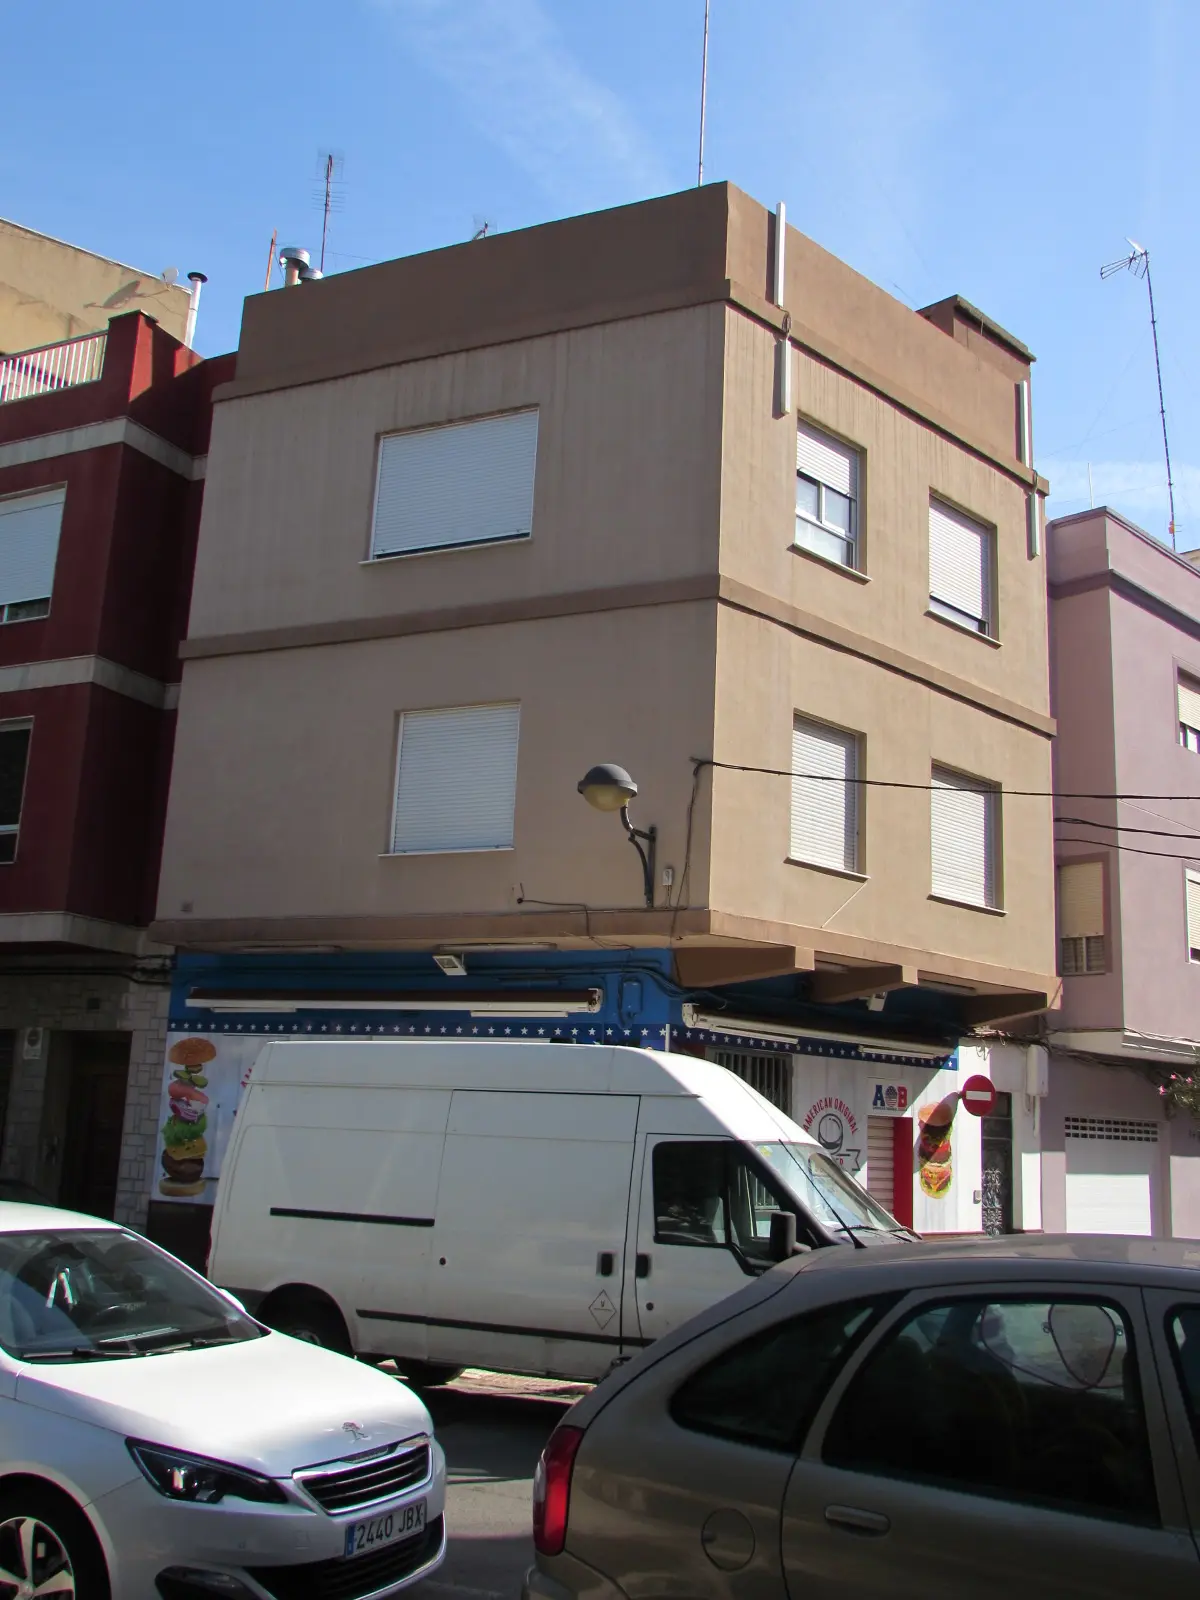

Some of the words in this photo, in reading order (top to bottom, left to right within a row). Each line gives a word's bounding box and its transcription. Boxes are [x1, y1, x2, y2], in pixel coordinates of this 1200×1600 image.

[802, 1097, 833, 1133] AMERICAN
[834, 1098, 859, 1136] ORIGINAL
[356, 1514, 393, 1550] 2440
[398, 1503, 423, 1533] JBX
